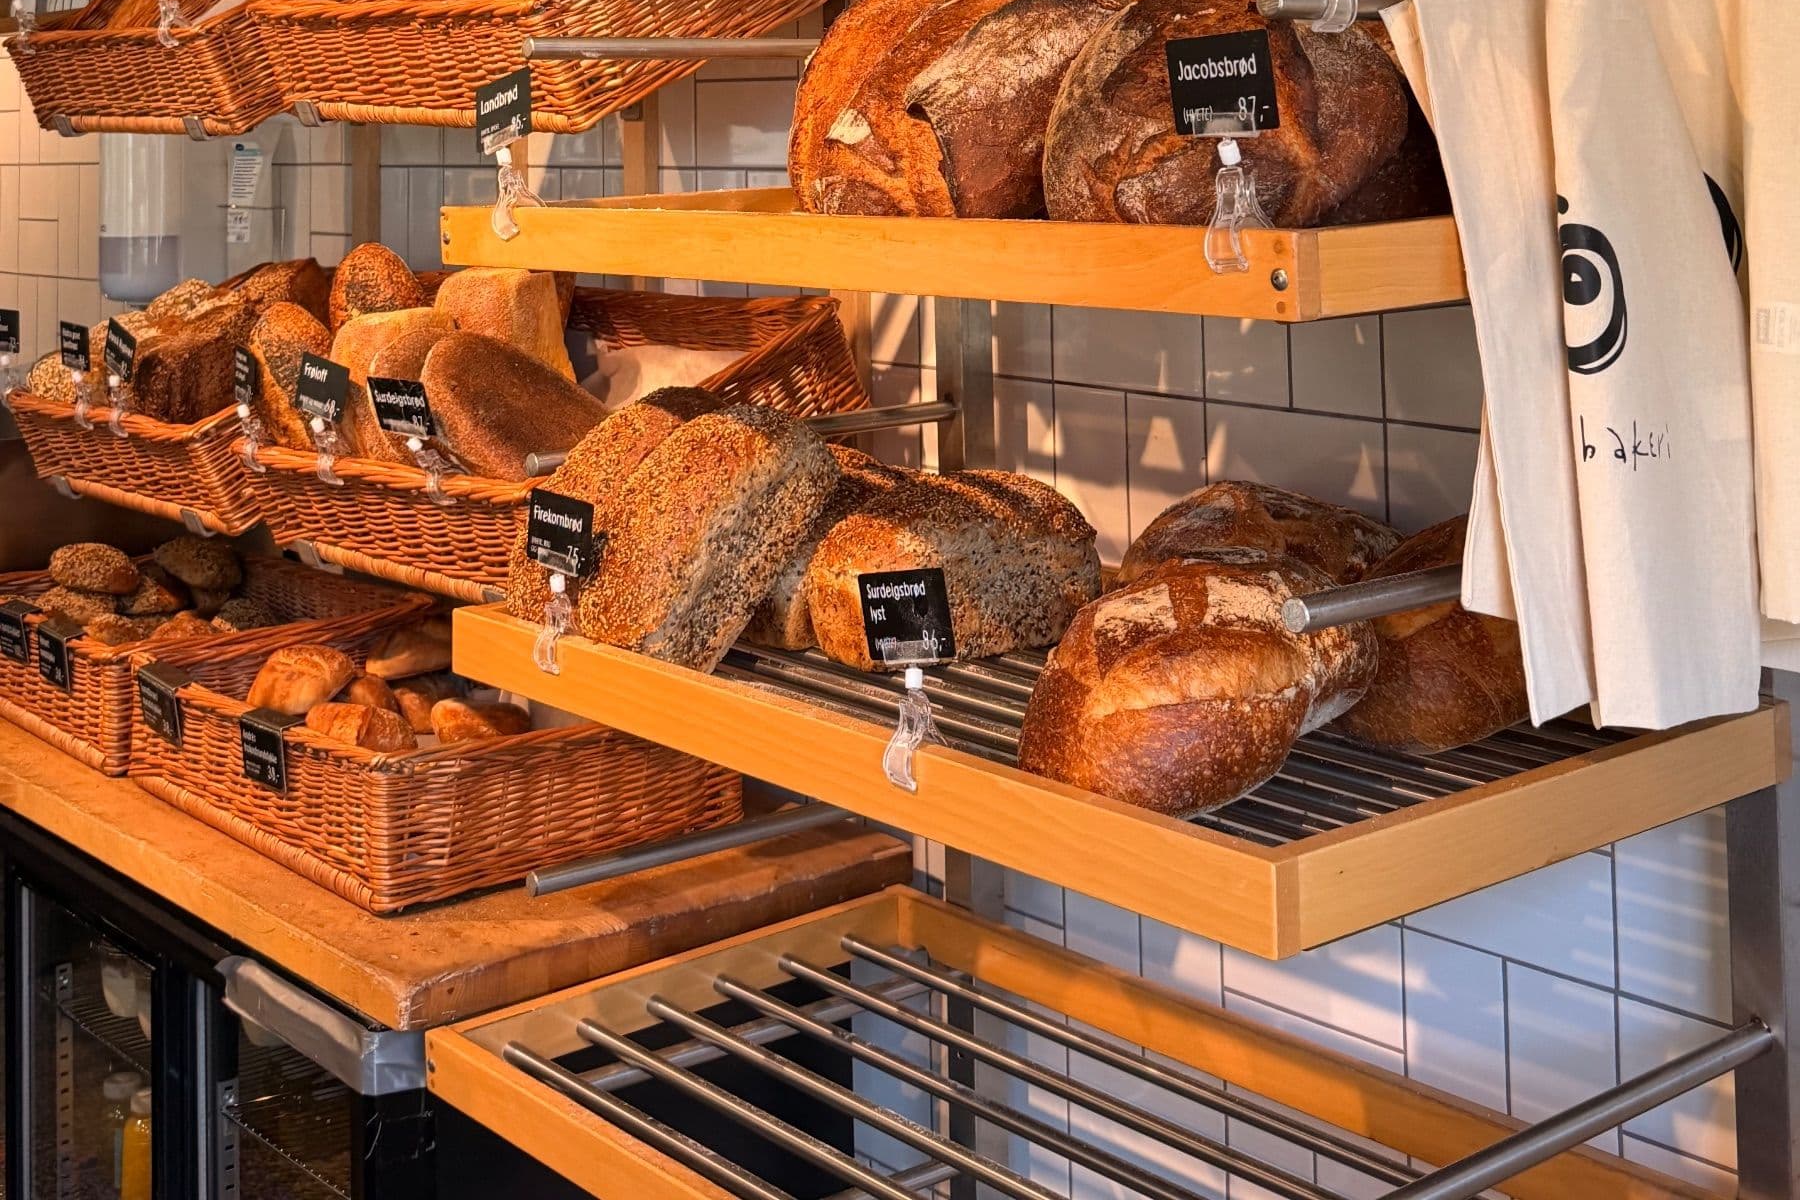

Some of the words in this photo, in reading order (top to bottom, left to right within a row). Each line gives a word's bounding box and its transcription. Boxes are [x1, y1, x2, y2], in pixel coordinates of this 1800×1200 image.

[1177, 52, 1257, 81] Jacobsbrød
[480, 83, 518, 116] Landbrød
[533, 504, 583, 533] Firekornbrød
[866, 580, 926, 601] Surdeigsbrød
[869, 605, 887, 625] lyst
